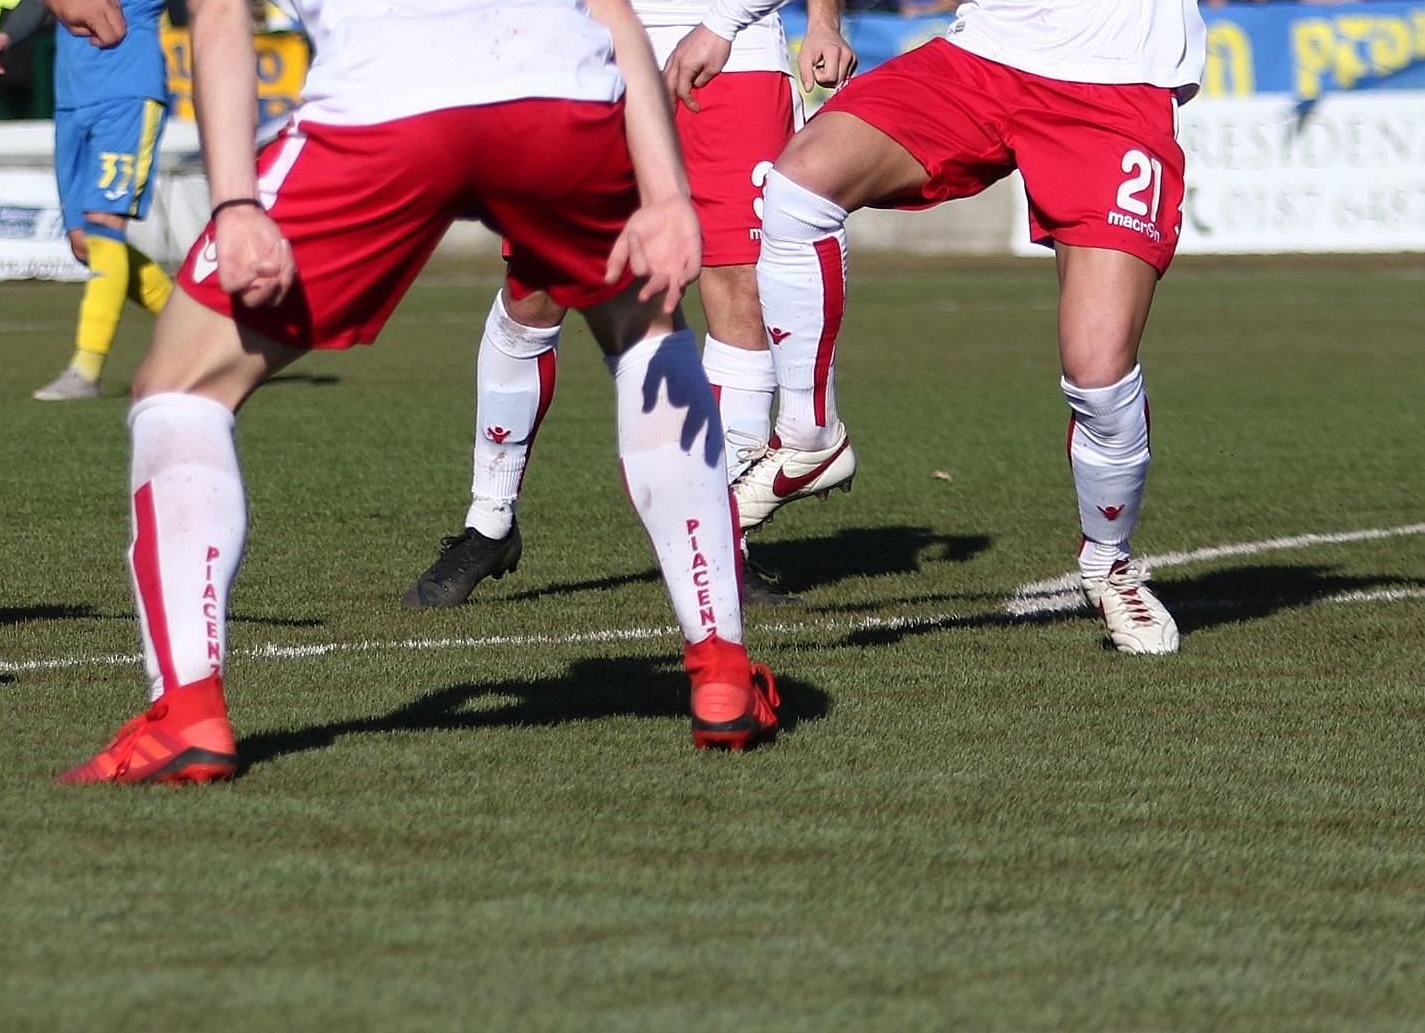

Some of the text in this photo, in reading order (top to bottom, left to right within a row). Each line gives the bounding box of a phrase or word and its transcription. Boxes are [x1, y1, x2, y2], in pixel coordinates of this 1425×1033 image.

[98, 152, 135, 189] 33
[1116, 149, 1163, 223] 21
[1107, 211, 1161, 243] macron
